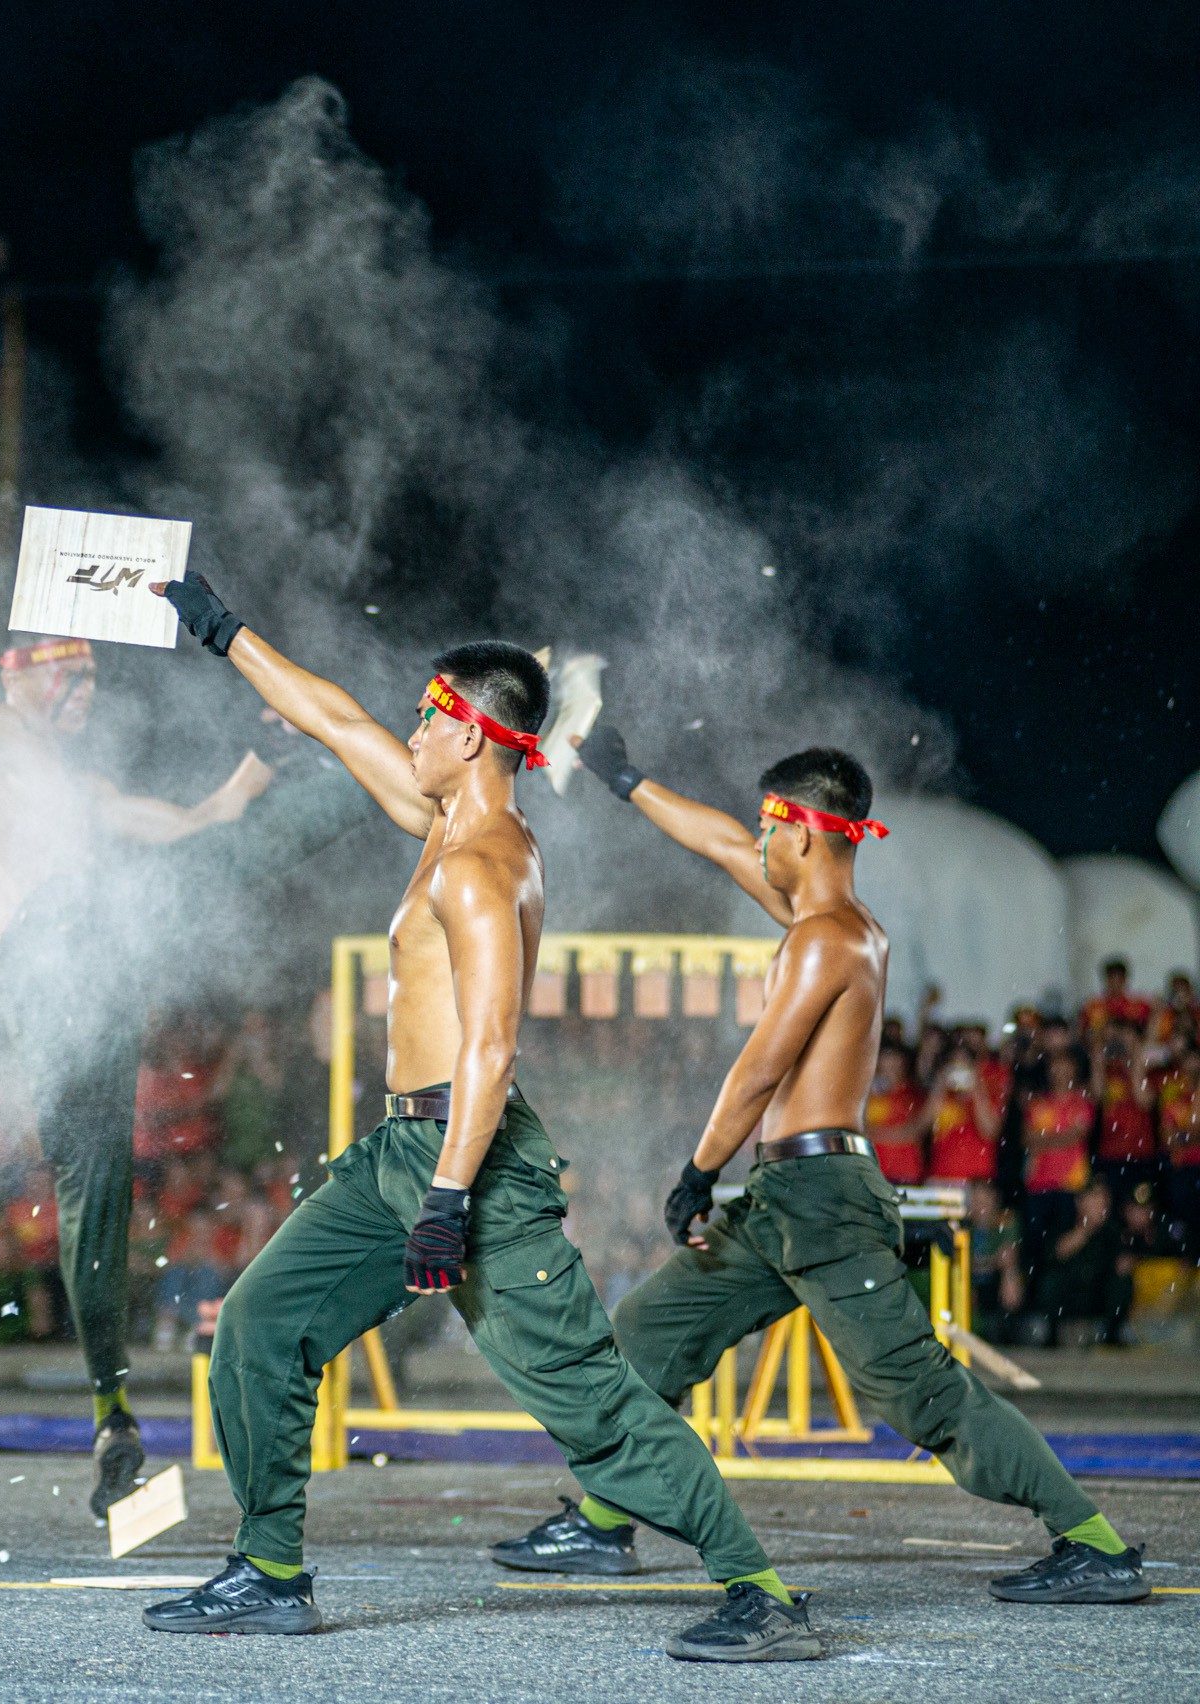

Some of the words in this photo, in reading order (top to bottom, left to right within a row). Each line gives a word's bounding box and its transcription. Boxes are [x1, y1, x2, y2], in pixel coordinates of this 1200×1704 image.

[60, 551, 95, 559] FEDERATION
[98, 553, 133, 562] TAEKWONDO
[66, 563, 145, 596] WTF
[446, 698, 455, 711] 3
